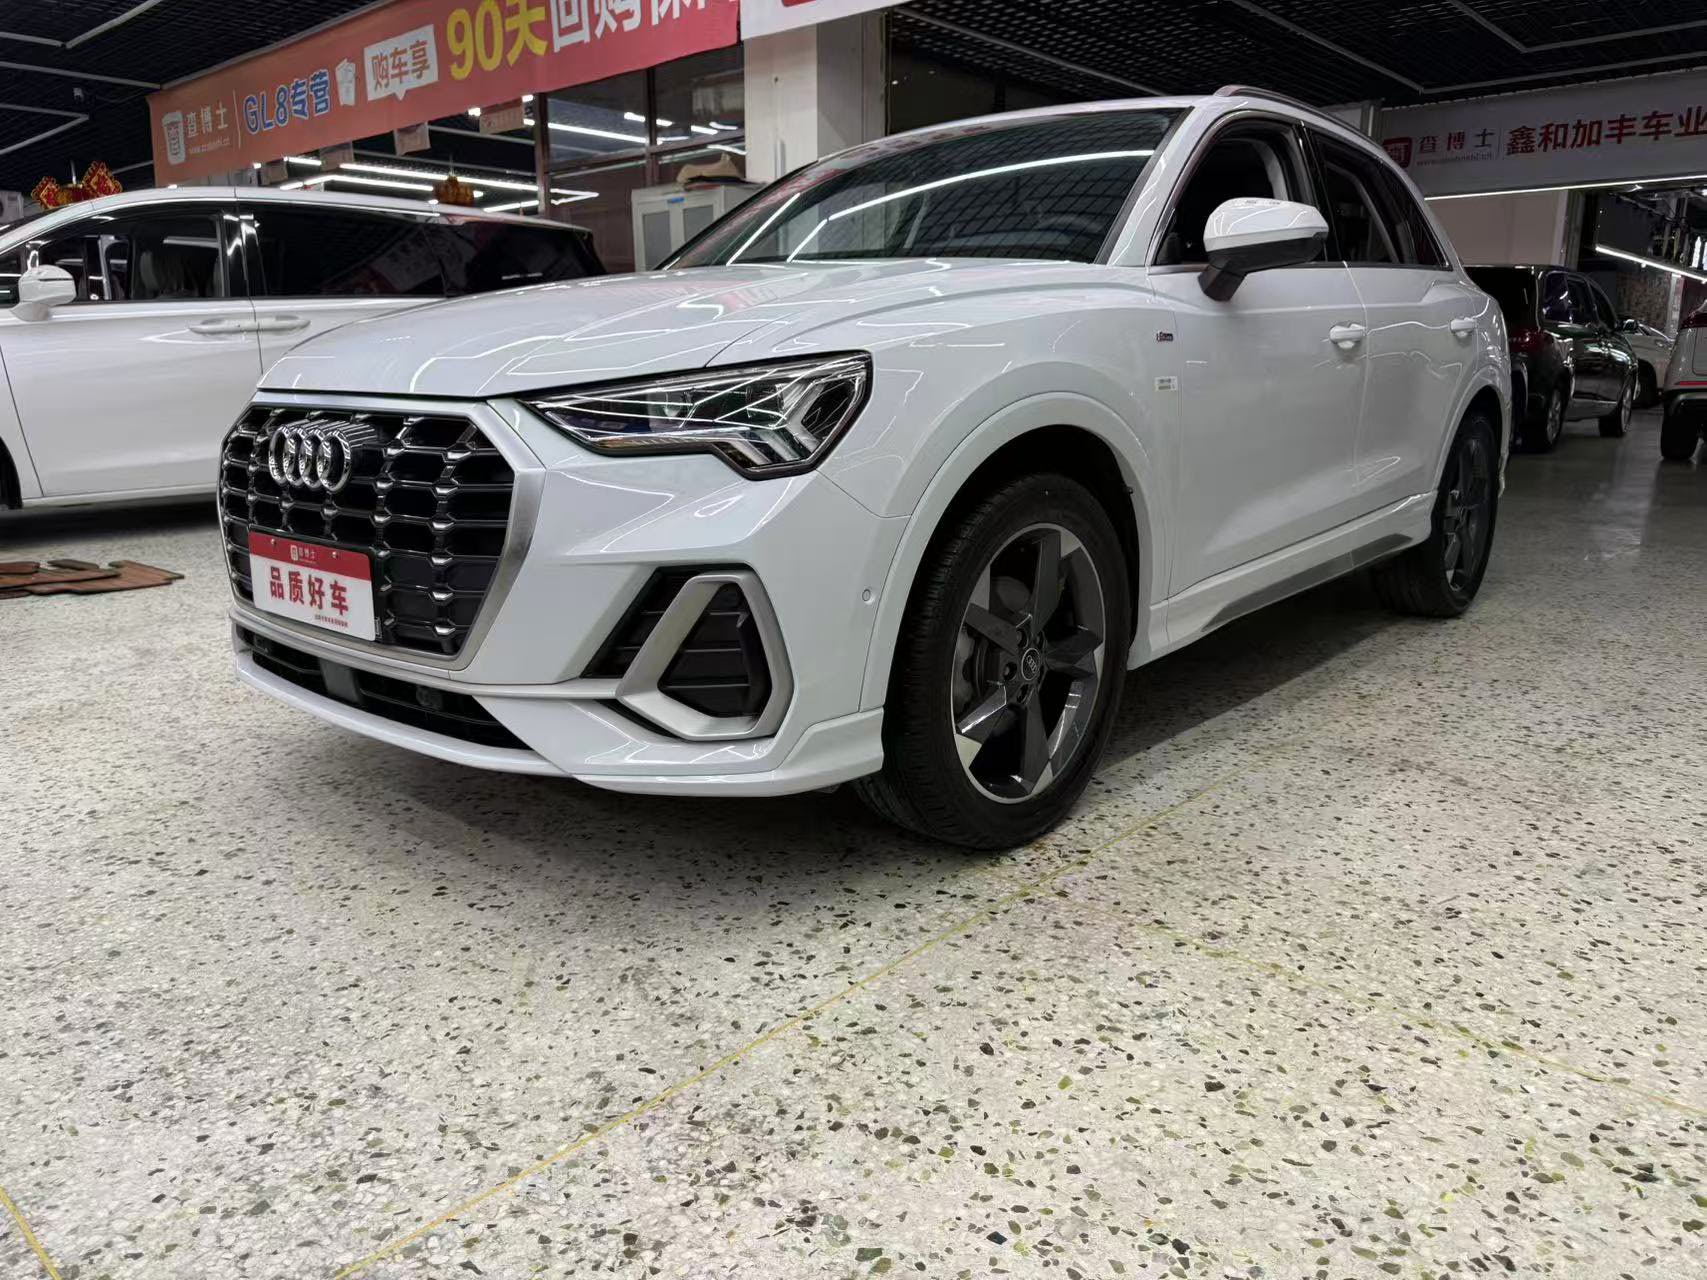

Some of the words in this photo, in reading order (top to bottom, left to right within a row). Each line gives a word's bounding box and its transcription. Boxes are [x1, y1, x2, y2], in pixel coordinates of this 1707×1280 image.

[243, 68, 330, 135] GL8专营
[371, 39, 431, 92] 购车享
[1506, 105, 1707, 156] 鑫和加丰车业
[270, 565, 349, 617] 品质好车
